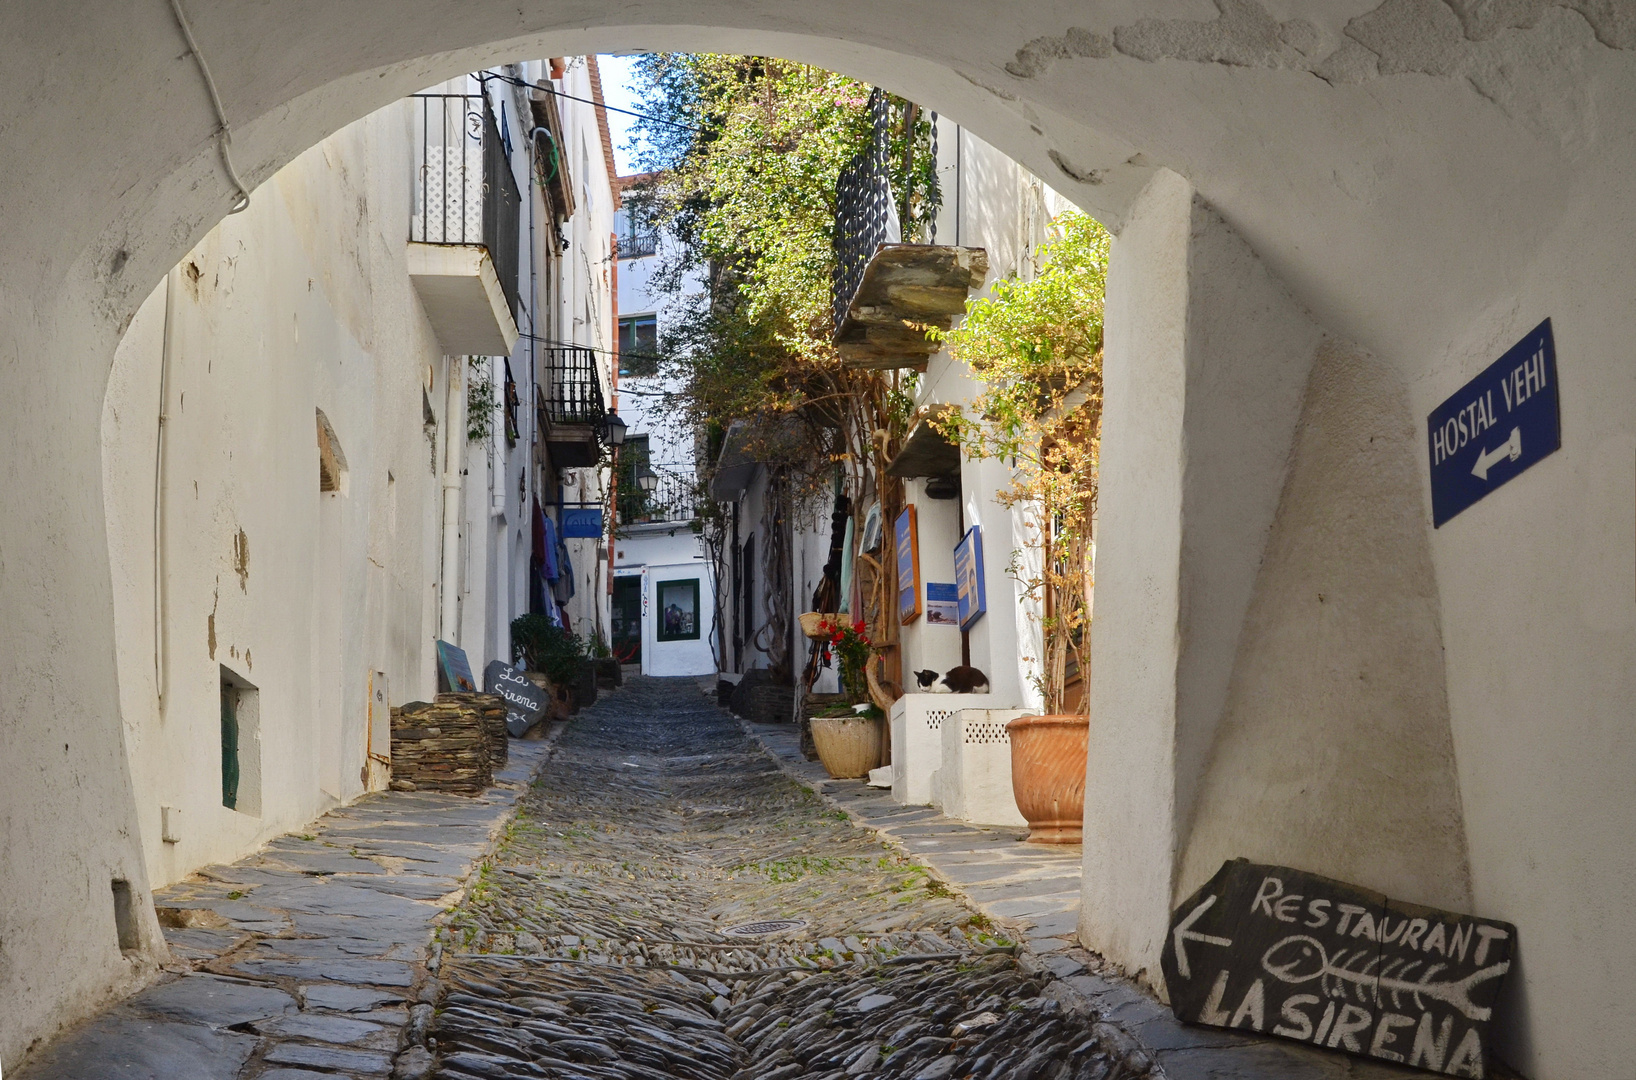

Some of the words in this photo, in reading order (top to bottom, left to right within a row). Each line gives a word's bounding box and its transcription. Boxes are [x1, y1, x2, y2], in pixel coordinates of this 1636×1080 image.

[1433, 389, 1497, 466] HOSTAL
[495, 683, 540, 711] Sirena
[499, 667, 529, 686] La
[1251, 876, 1511, 966] RESTAURANT
[1200, 969, 1265, 1032] LA
[1274, 994, 1485, 1080] SIRENA
